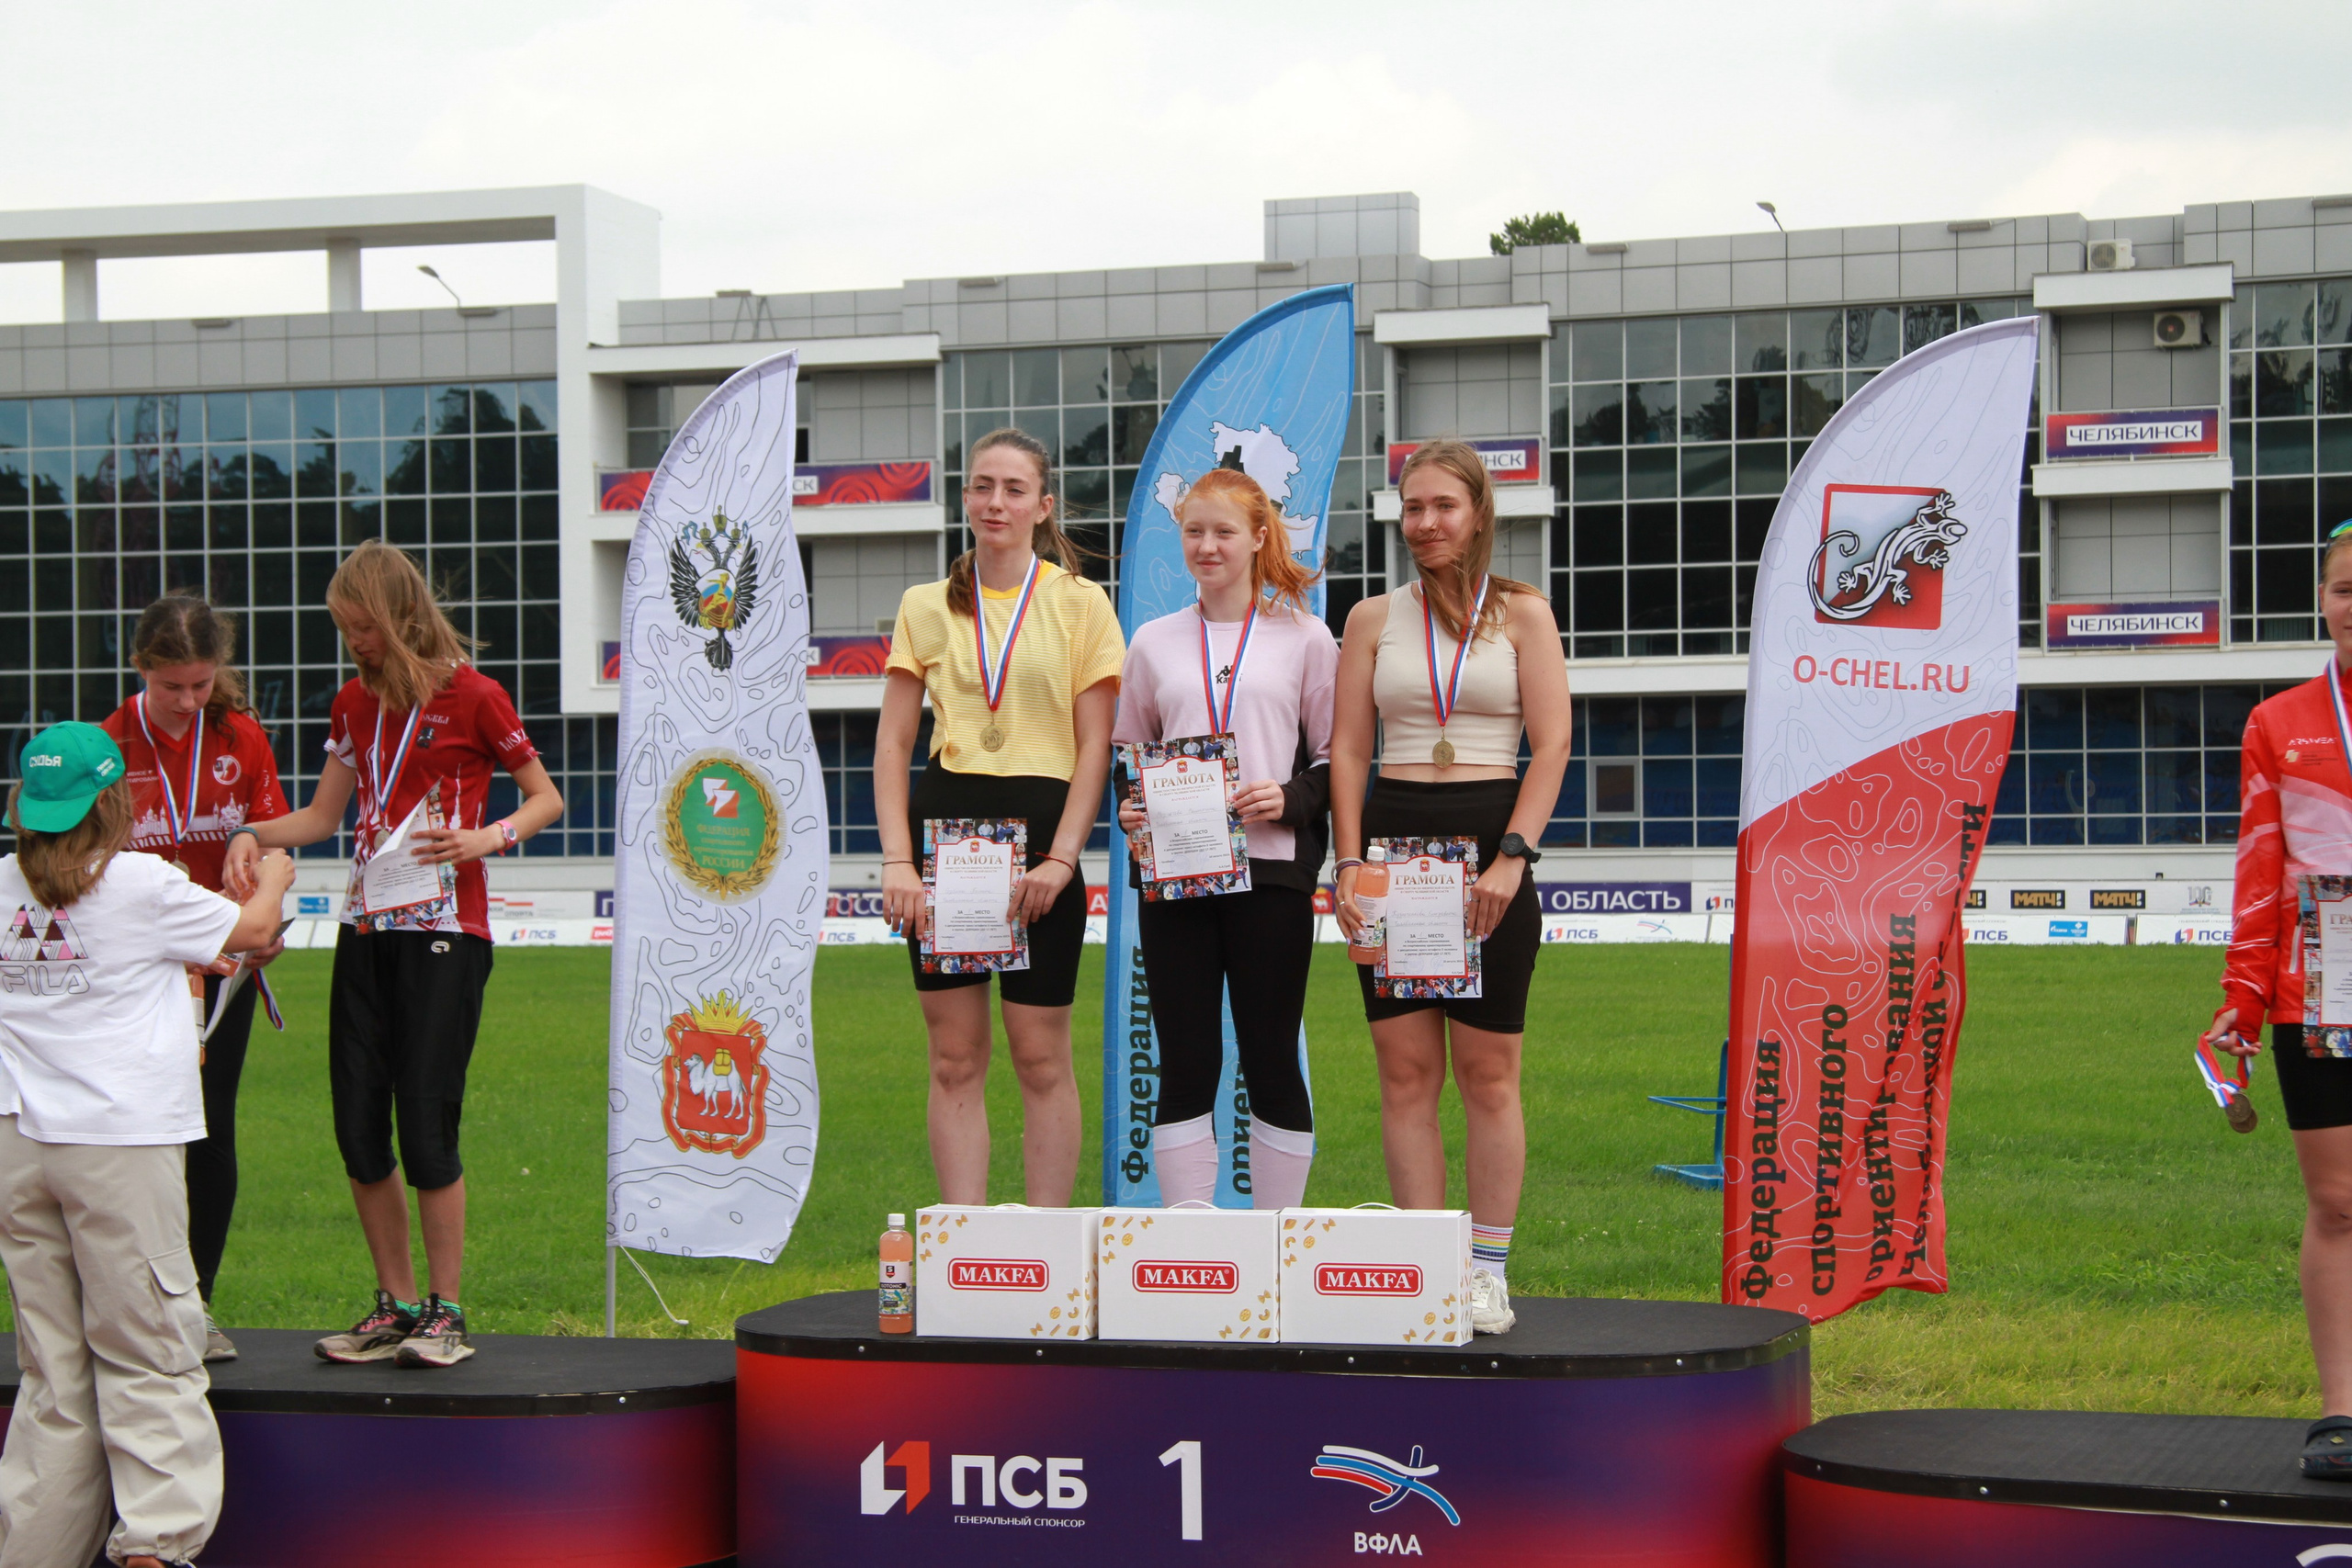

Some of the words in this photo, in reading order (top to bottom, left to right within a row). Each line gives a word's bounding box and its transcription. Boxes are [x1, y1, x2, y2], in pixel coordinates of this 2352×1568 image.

[2069, 424, 2198, 442] ЧЕЛЯБИНСК
[2070, 615, 2199, 632] ЧЕЛЯБИНСК
[1792, 654, 1970, 694] O-CHEL.RU
[29, 754, 62, 768] СУДЬЯ
[1152, 773, 1216, 789] ГРАМОТА
[702, 855, 745, 869] РОССИИ
[945, 854, 1002, 865] ГРАМОТА
[1396, 874, 1454, 886] ГРАМОТА
[1551, 890, 1681, 910] ОБЛАСТЬ
[528, 930, 556, 940] ПСБ
[827, 932, 855, 942] ПСБ
[1566, 929, 1598, 940] ПСБ
[1973, 930, 2008, 941] ПСБ
[2199, 931, 2233, 942] ПСБ
[0, 964, 90, 996] FILA
[1811, 1003, 1849, 1296] спортивного
[1740, 1039, 1787, 1300] Федерация
[951, 1454, 1088, 1508] ПСБ
[1159, 1440, 1203, 1540] 1
[954, 1516, 1031, 1526] ГЕНЕРАЛЬНЫЙ
[1034, 1517, 1086, 1528] СПОНСОР
[1353, 1532, 1423, 1555] ВФЛА
